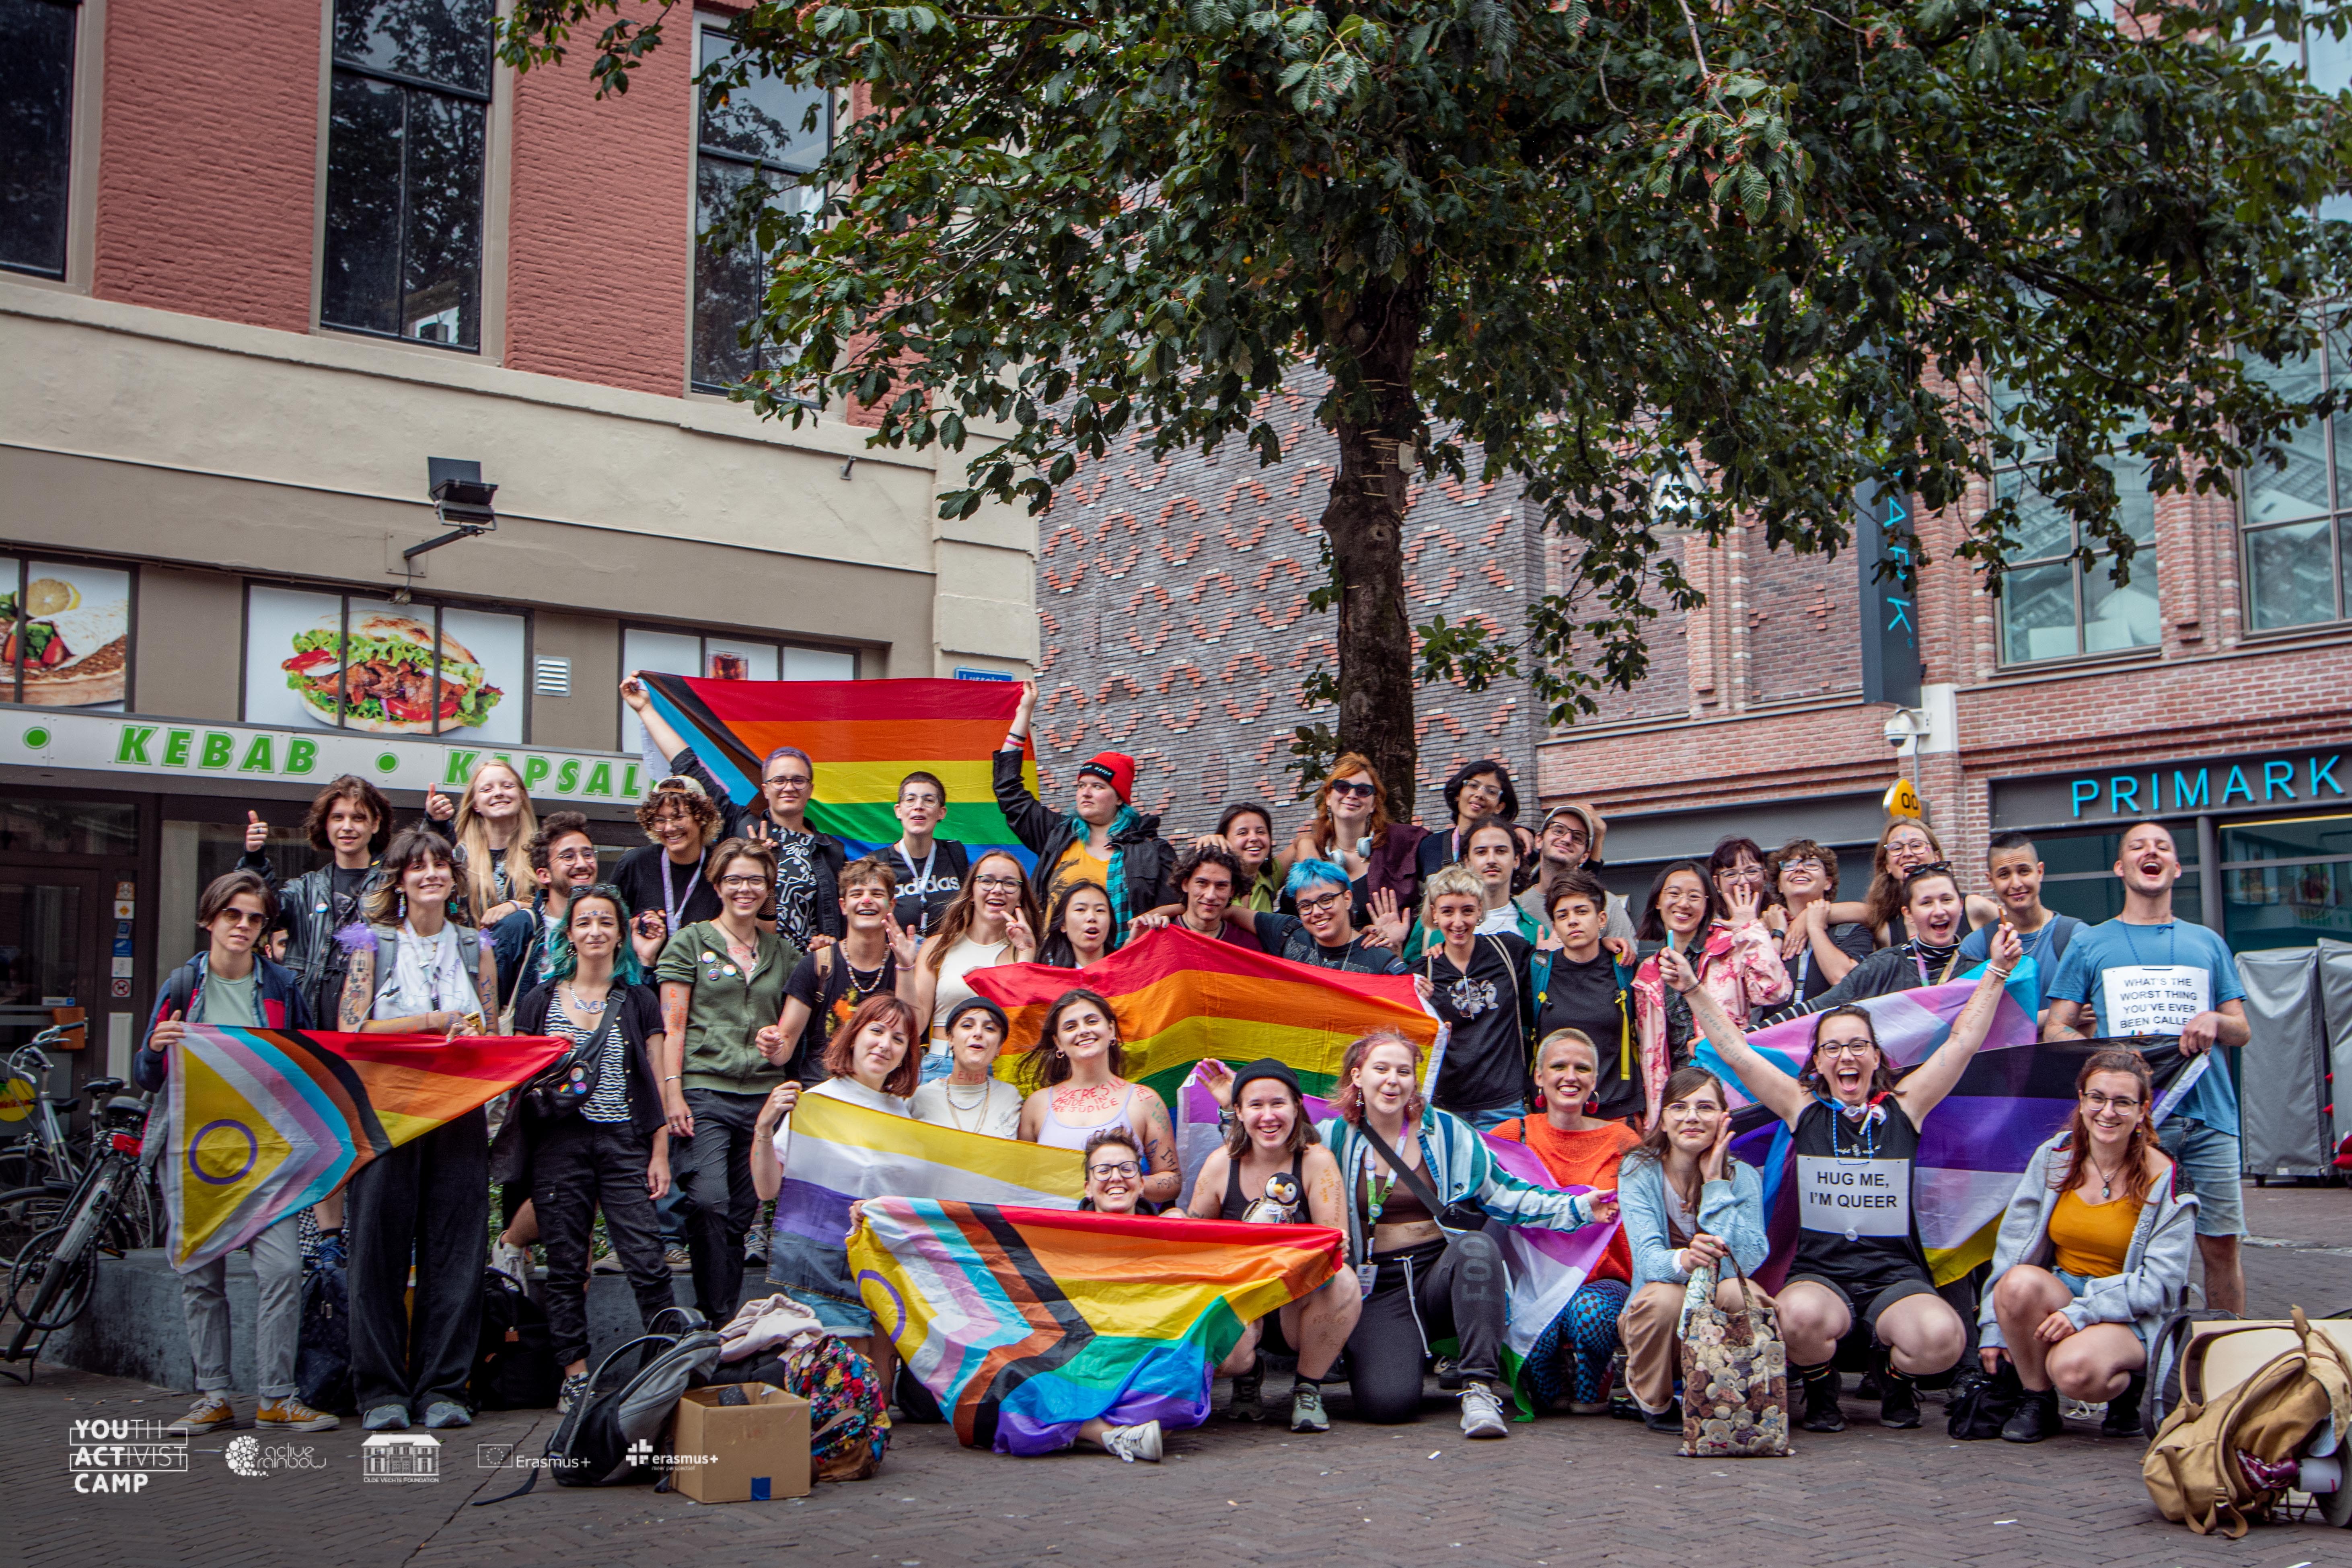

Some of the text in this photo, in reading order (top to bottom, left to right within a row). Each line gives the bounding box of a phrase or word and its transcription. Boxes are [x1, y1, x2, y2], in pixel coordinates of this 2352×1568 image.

[115, 724, 319, 775] KEBAB
[2071, 754, 2345, 818] PRIMARK
[2124, 978, 2192, 987] WHAT'S THE
[2120, 990, 2198, 1001] WORST THING
[2123, 1003, 2197, 1014] YOU'VE EVER
[2120, 1016, 2192, 1029] BEEN CALLE
[1051, 1097, 1119, 1113] PREJUDICE
[1053, 1094, 1108, 1106] PRIDE IN
[1817, 1171, 1889, 1189] HUG ME,
[1810, 1192, 1898, 1208] I'M QUEER
